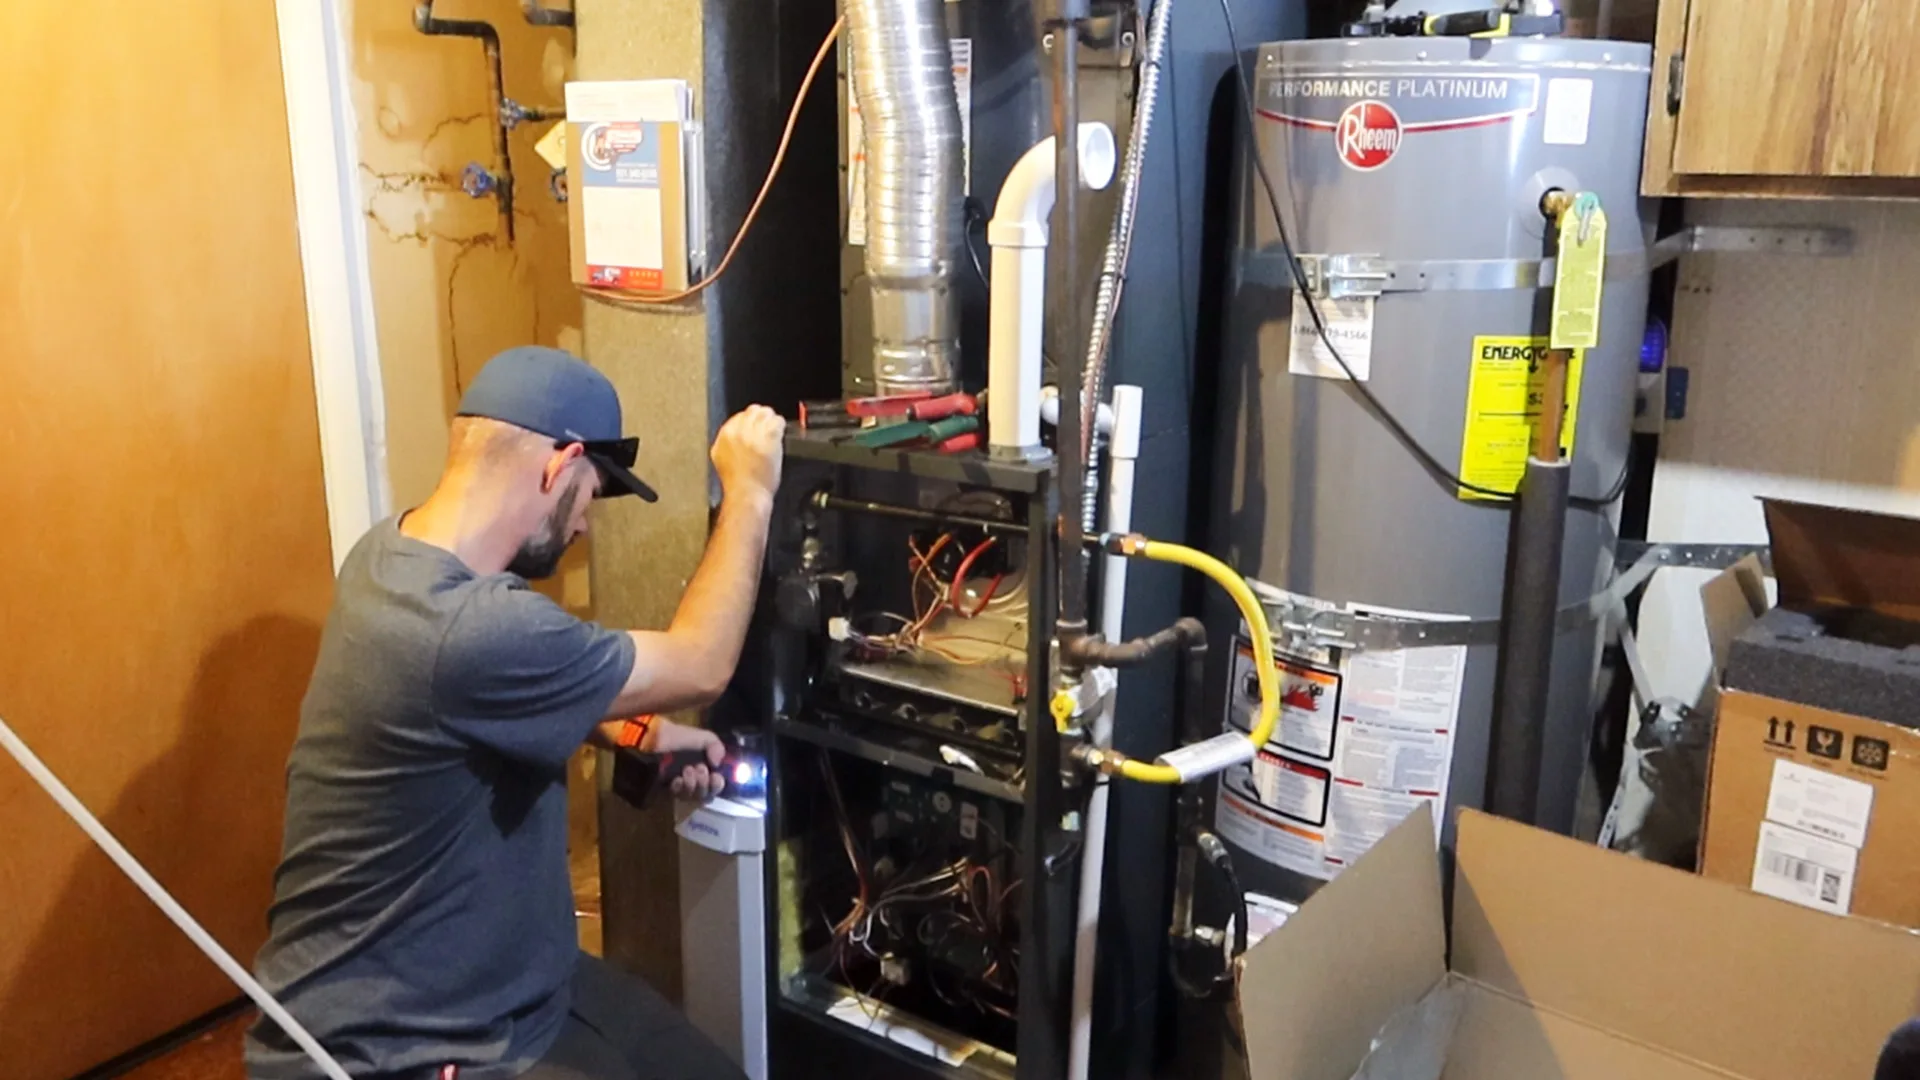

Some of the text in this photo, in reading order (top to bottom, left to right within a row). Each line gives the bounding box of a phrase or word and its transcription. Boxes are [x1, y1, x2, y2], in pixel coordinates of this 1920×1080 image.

[1268, 80, 1508, 99] PERFORMANCE PLATINUM
[1343, 103, 1397, 159] Rheem
